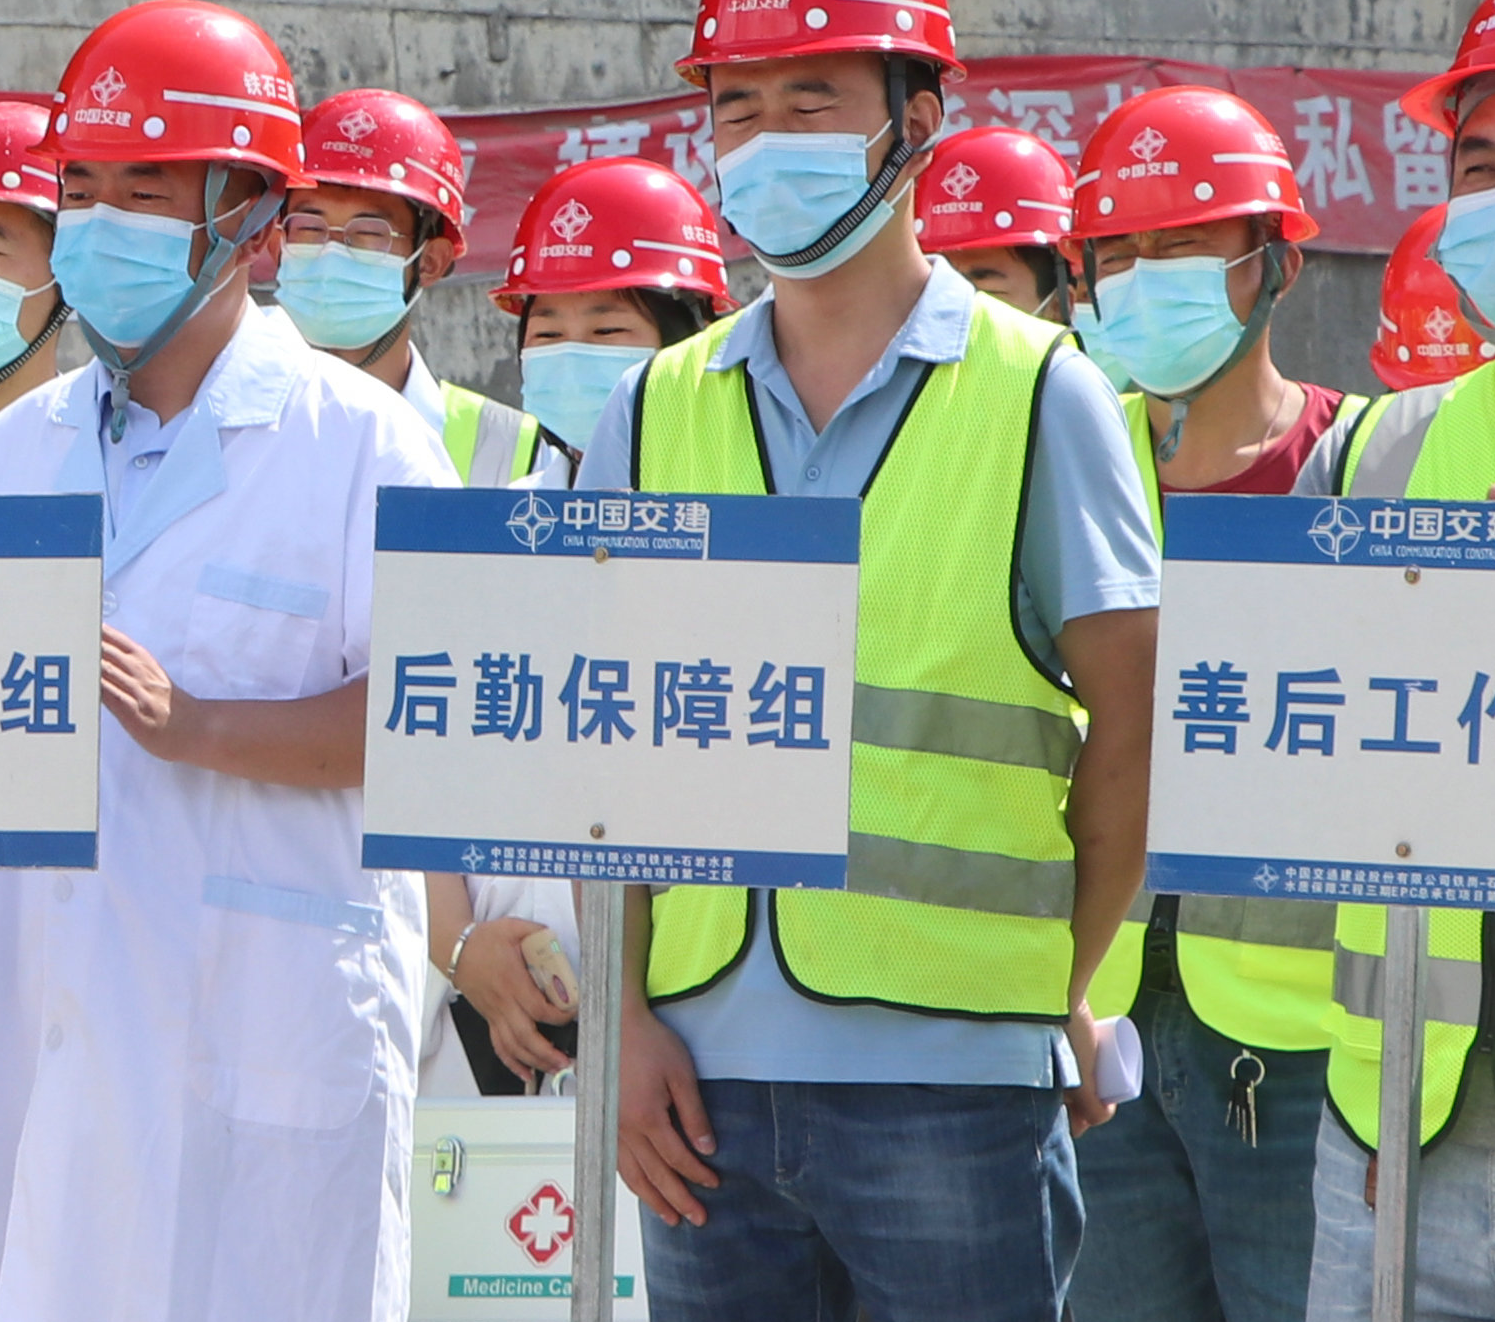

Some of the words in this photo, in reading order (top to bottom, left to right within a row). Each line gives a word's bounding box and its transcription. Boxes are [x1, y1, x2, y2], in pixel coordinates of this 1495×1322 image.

[74, 108, 132, 127] 中国交建
[1117, 161, 1179, 181] 中国交建
[563, 498, 709, 533] 中国交建
[652, 538, 704, 551] CONSTRUCTIO
[384, 651, 830, 750] 后勤保障组
[463, 1278, 544, 1296] Medicine
